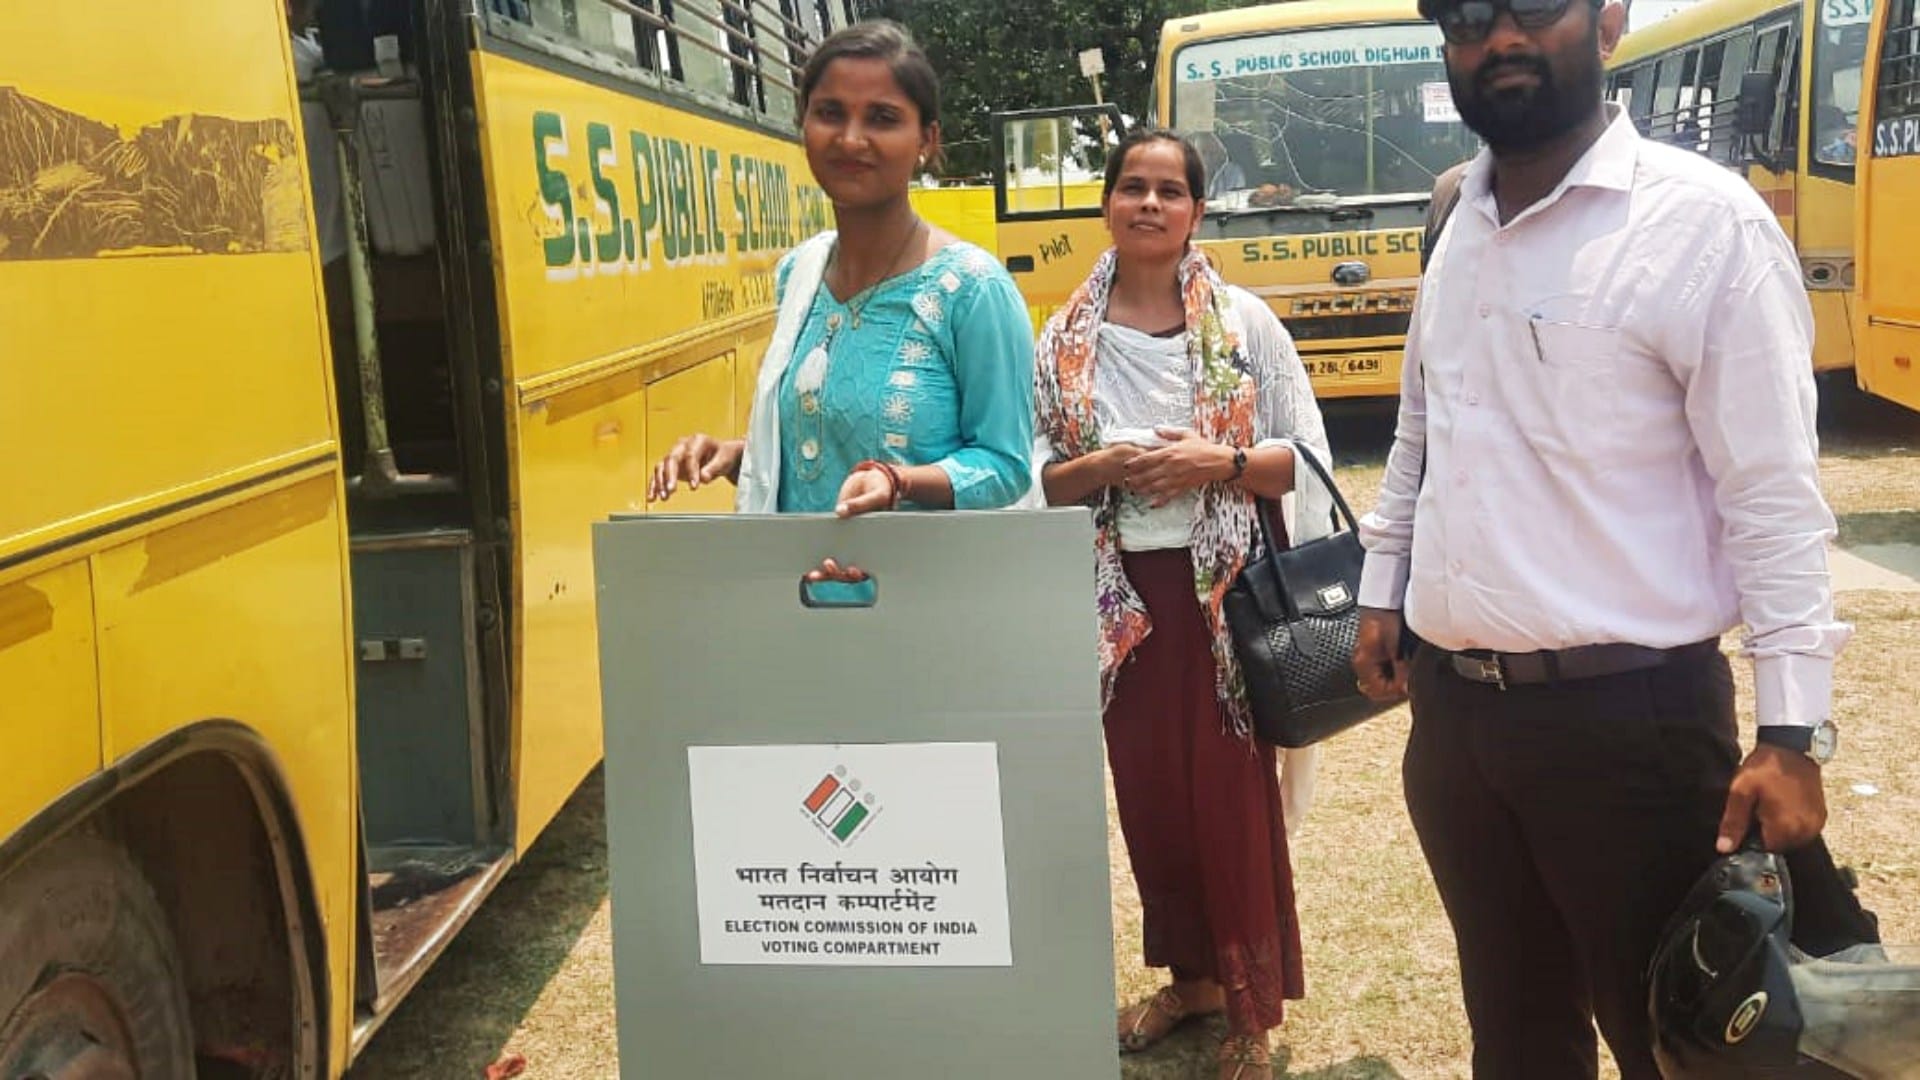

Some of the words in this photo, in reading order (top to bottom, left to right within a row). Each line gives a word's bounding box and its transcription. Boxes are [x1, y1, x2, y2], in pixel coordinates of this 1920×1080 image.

[1236, 54, 1293, 73] PUBLIC
[1299, 49, 1360, 67] SCHOOL
[1365, 46, 1430, 63] DIGHWA
[730, 154, 794, 252] SCHOOL
[1302, 235, 1377, 259] PUBLIC
[735, 867, 788, 884] भारत
[798, 861, 878, 884] निर्वाचन
[890, 861, 958, 884] आयोग
[758, 894, 827, 912] मतदान
[724, 920, 800, 933] ELECTION
[804, 920, 903, 934] COMMISSION
[907, 921, 928, 934] OF
[933, 921, 978, 935] INDIA
[761, 940, 819, 953] VOTING
[823, 941, 941, 955] COMPARTMENT
